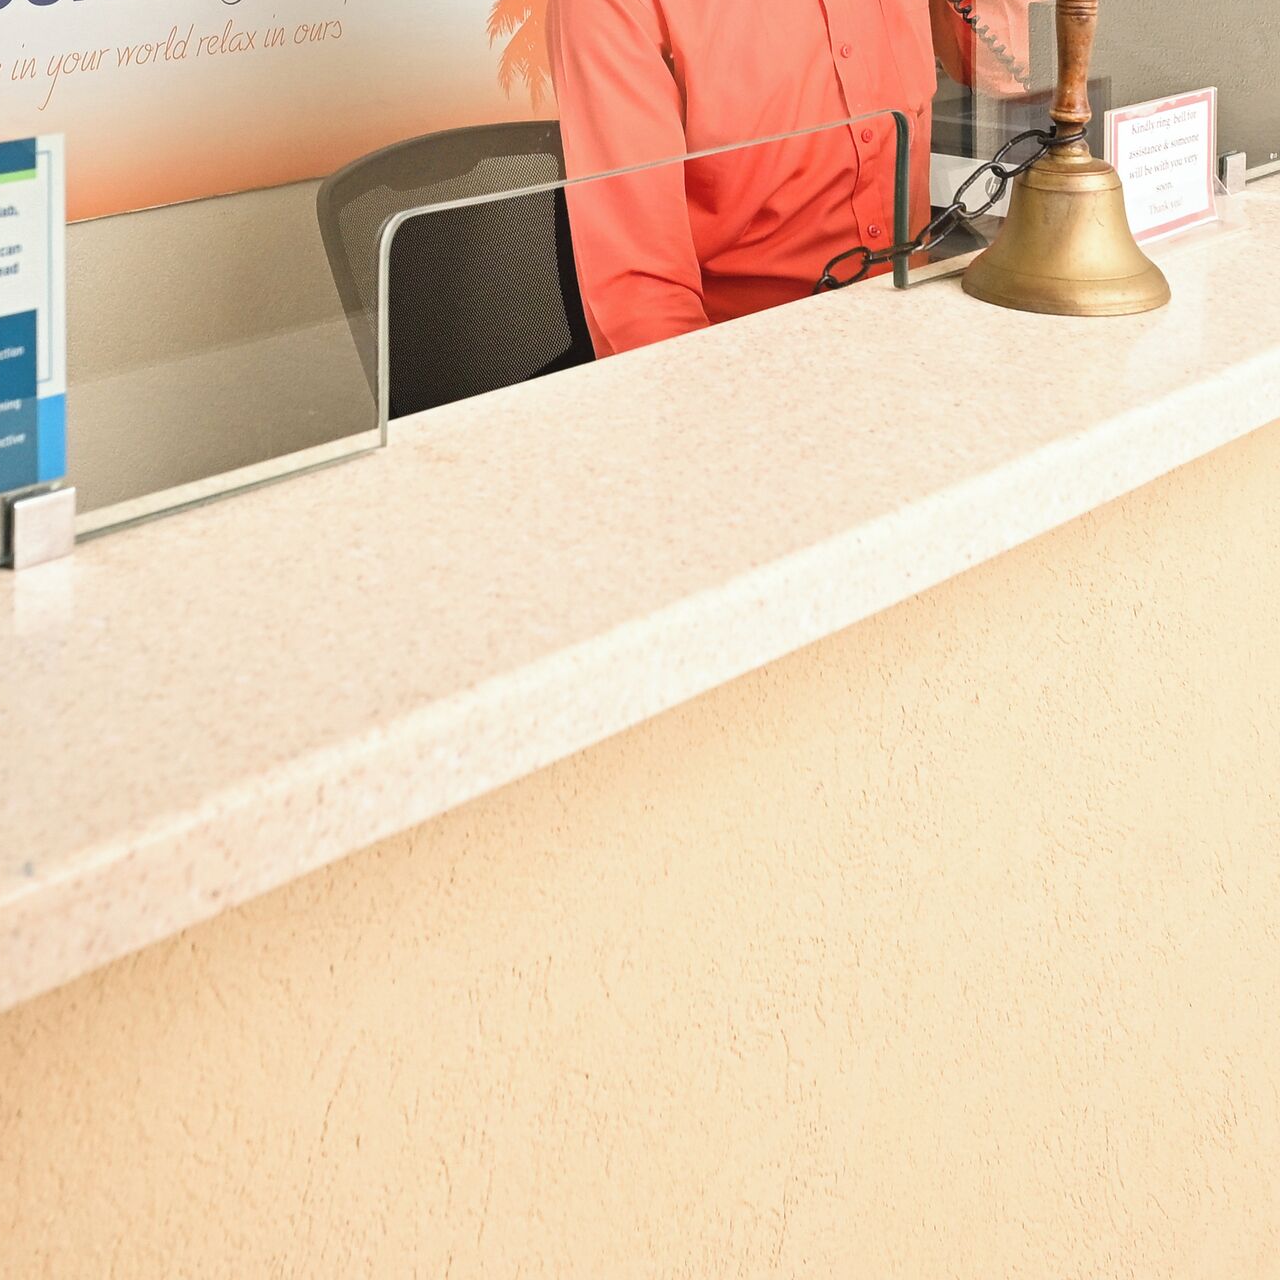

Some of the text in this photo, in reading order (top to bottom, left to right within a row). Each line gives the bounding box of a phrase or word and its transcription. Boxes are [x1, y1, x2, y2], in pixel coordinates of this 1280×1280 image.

[11, 43, 37, 81] in
[38, 47, 110, 111] your
[117, 23, 194, 68] world
[196, 19, 258, 57] relax
[263, 14, 285, 48] in
